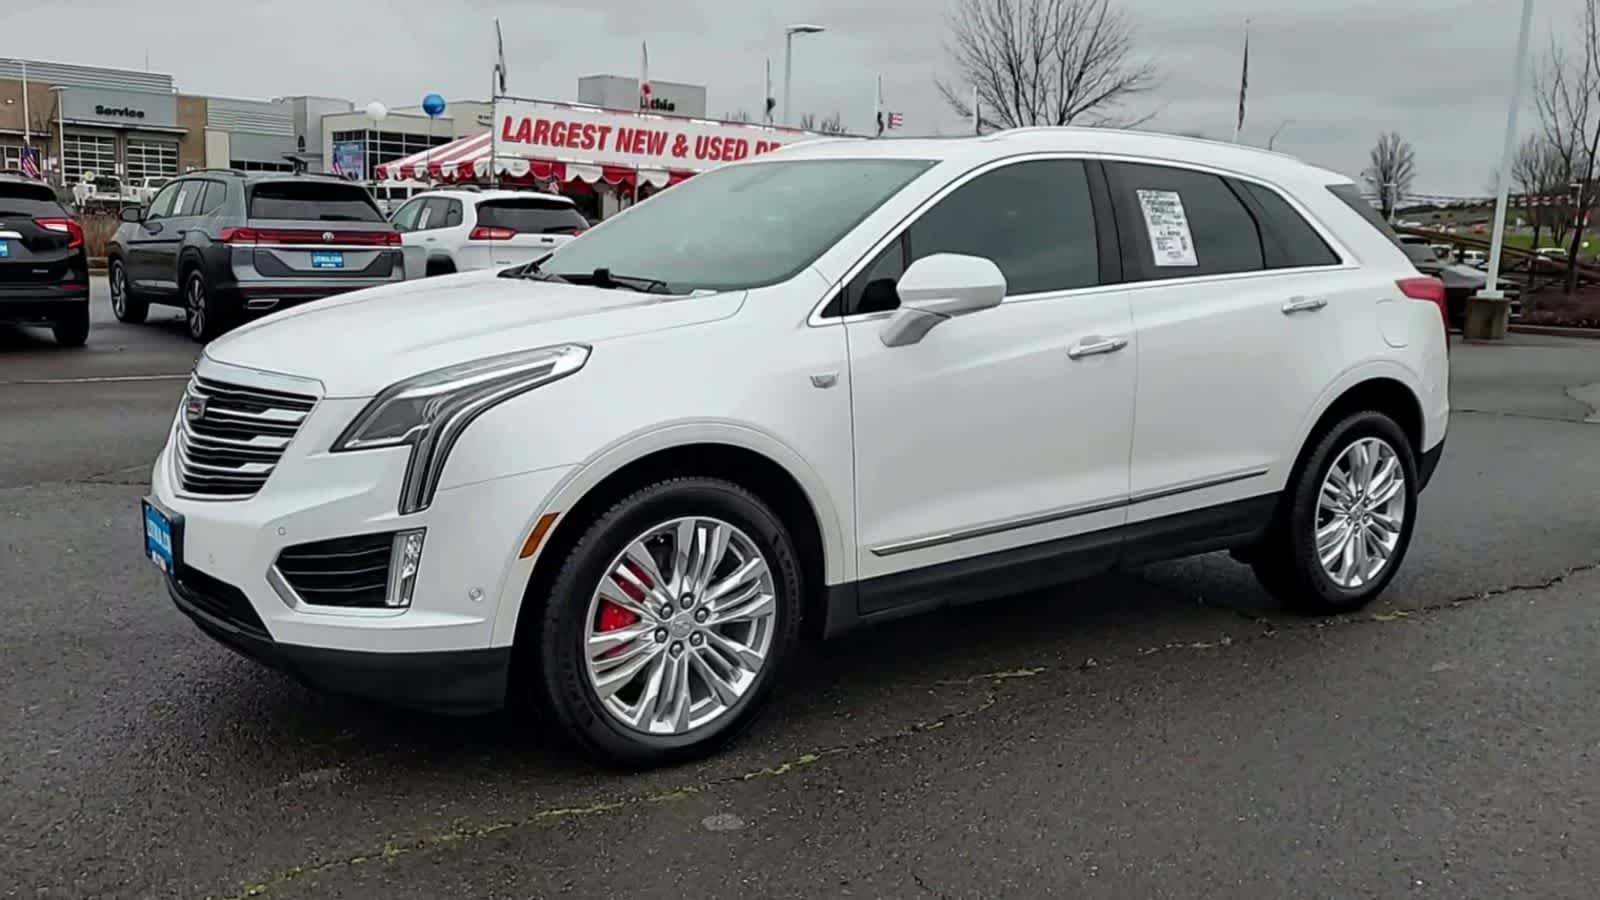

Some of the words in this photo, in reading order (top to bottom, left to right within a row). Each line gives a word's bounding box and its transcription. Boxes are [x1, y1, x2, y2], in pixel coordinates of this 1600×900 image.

[96, 105, 144, 118] Service
[501, 116, 611, 151] LARGEST
[615, 128, 667, 155] NEW
[672, 133, 688, 157] &
[695, 136, 749, 161] USED
